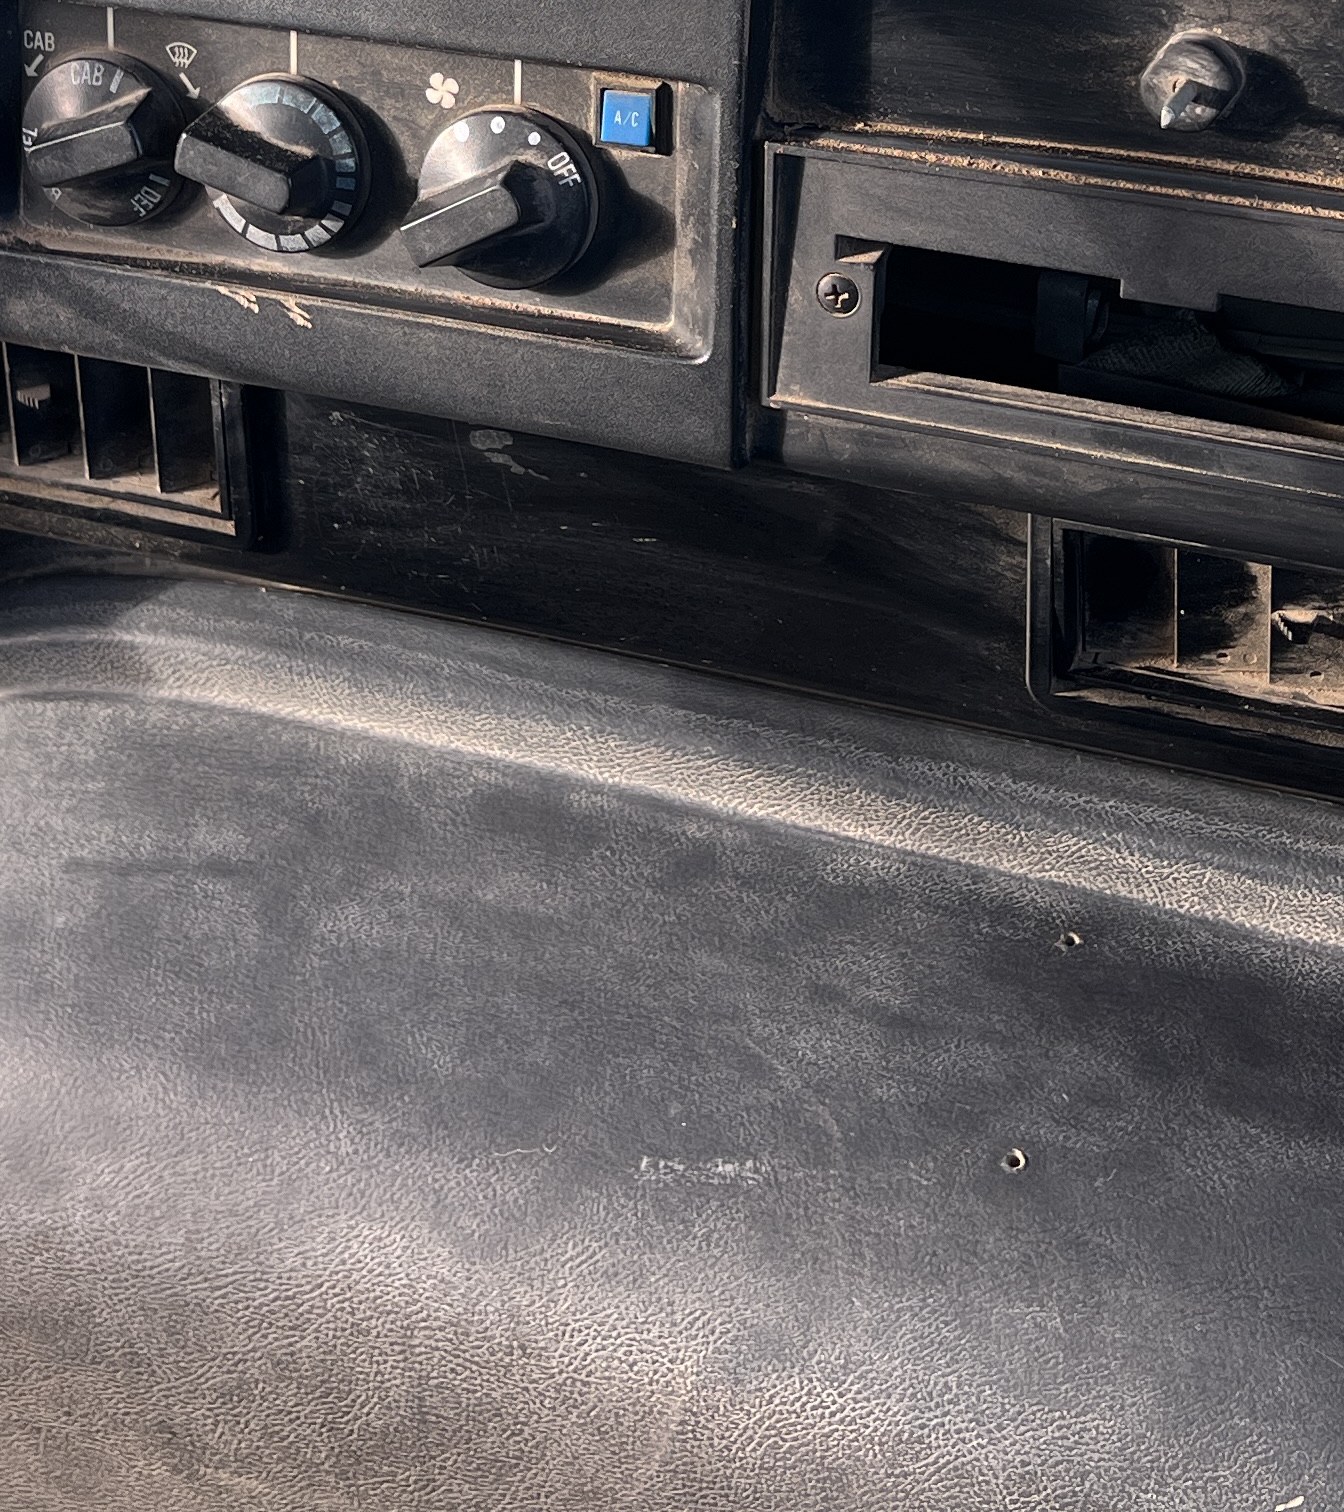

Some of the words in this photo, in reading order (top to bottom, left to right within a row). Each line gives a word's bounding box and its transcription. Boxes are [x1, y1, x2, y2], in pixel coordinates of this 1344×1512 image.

[23, 29, 55, 51] CAB
[70, 62, 105, 86] CAB
[613, 110, 640, 128] A/C
[545, 151, 580, 191] OFF
